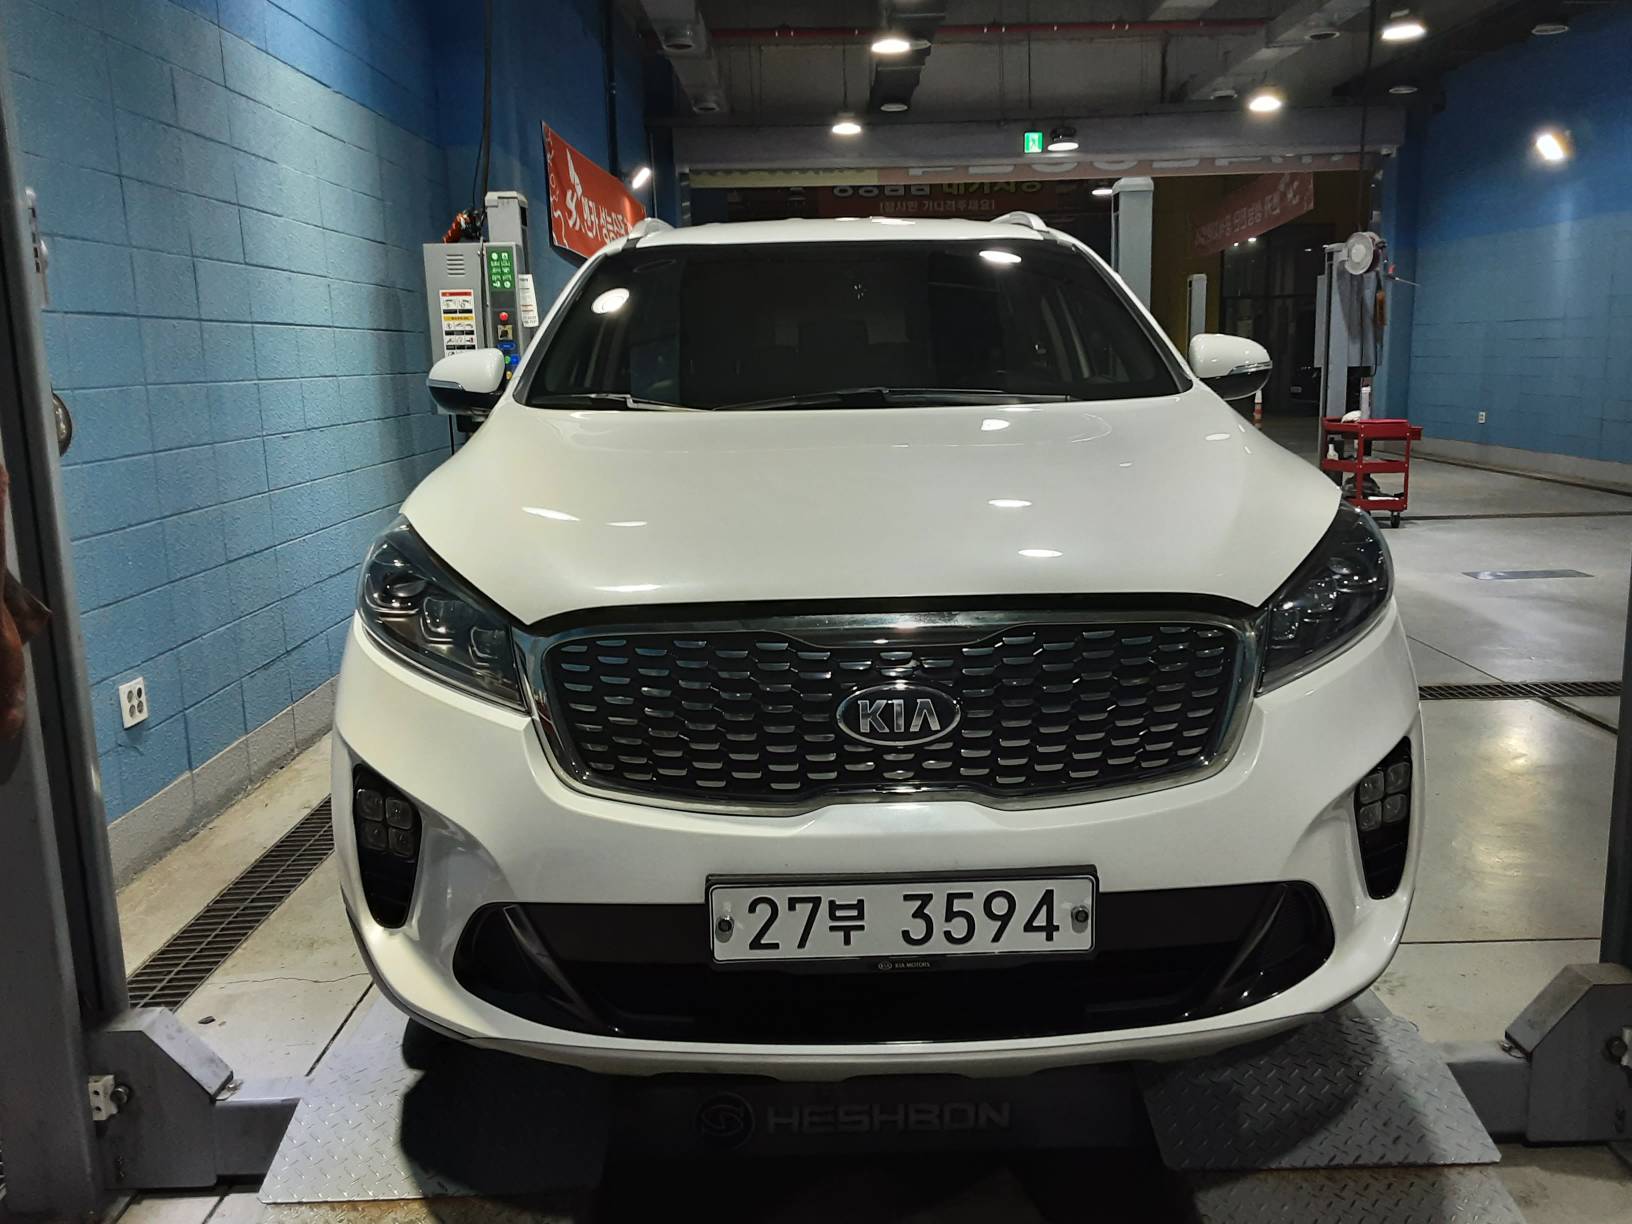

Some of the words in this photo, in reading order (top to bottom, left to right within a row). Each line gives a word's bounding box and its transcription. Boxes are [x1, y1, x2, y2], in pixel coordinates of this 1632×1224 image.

[857, 698, 941, 733] KIA
[747, 896, 866, 951] 27부
[900, 889, 1060, 947] 3594
[767, 1101, 1011, 1134] HESHBON
